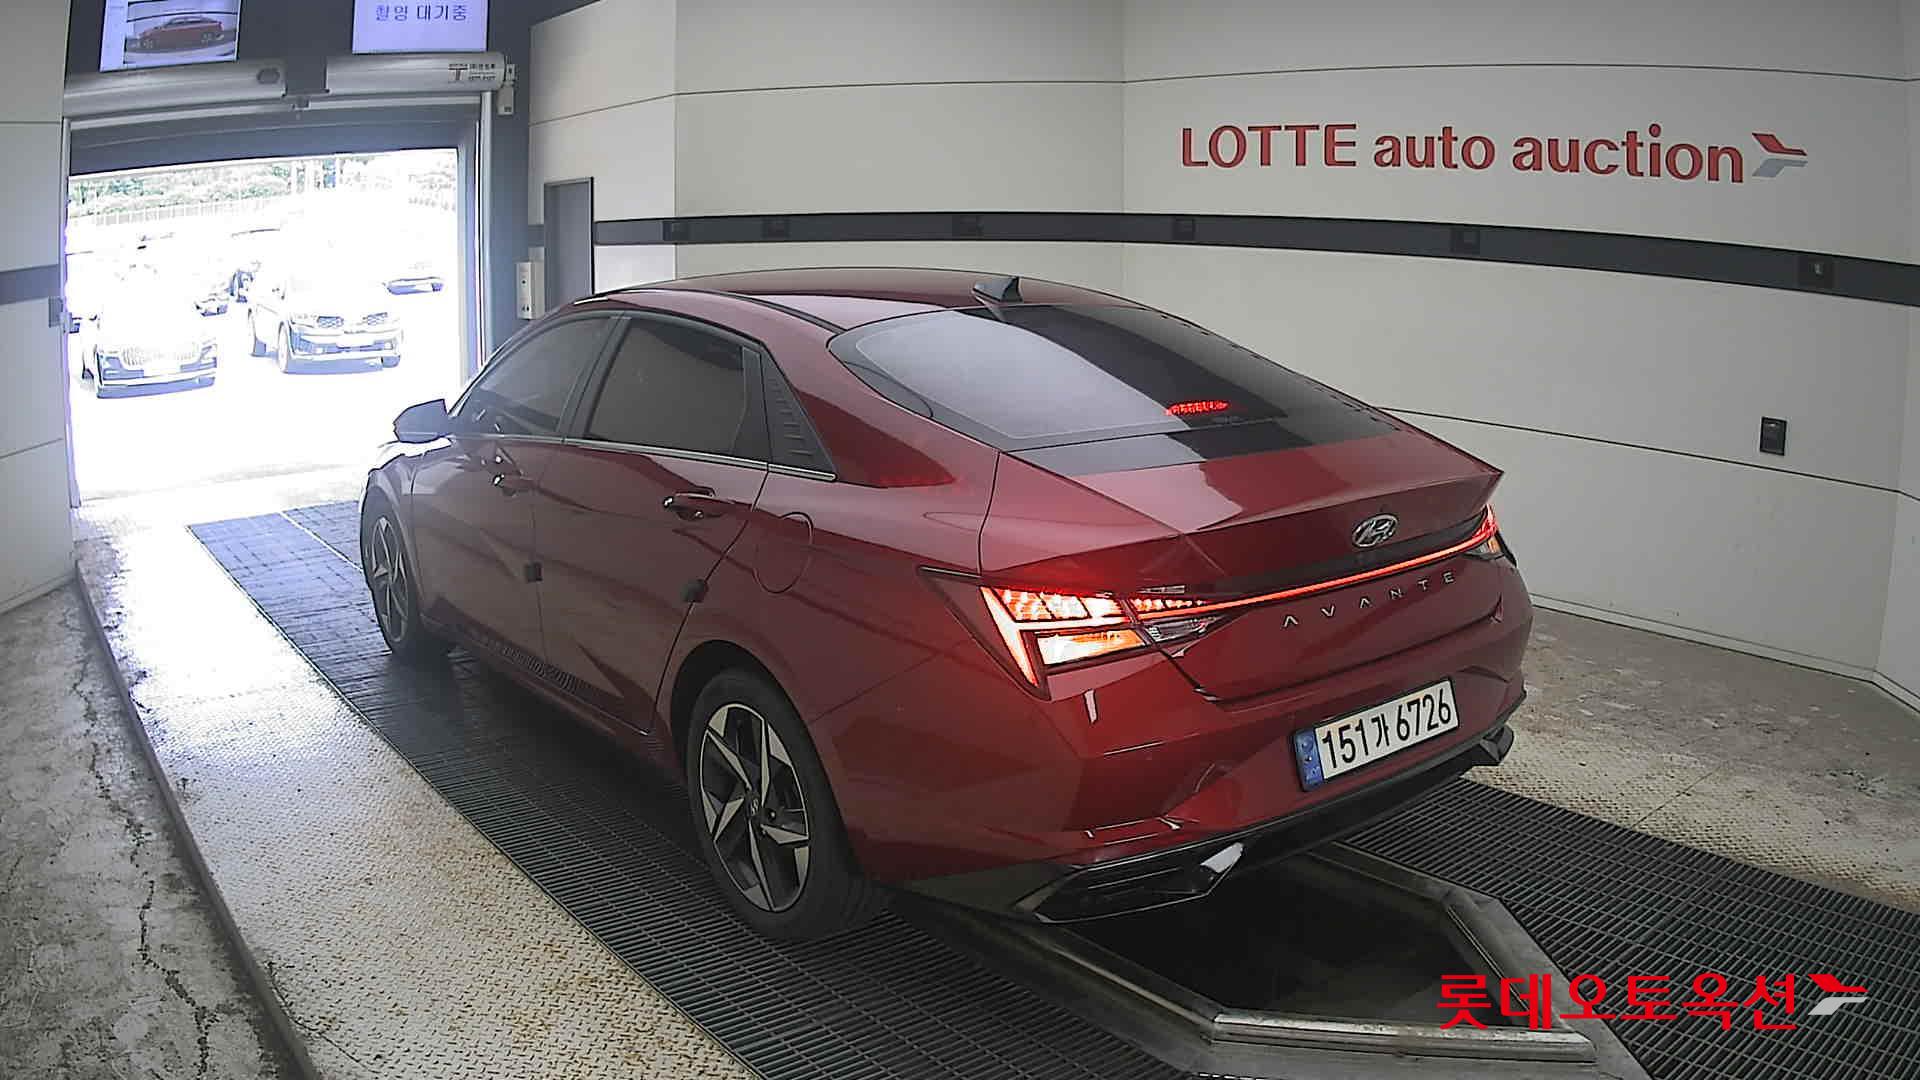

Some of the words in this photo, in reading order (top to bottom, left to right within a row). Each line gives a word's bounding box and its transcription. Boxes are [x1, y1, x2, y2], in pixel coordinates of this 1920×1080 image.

[416, 4, 467, 22] 대기중
[1182, 124, 1357, 169] LOTTE
[1374, 127, 1496, 170] auto
[1513, 123, 1744, 183] auction
[1282, 571, 1455, 628] AVANTE
